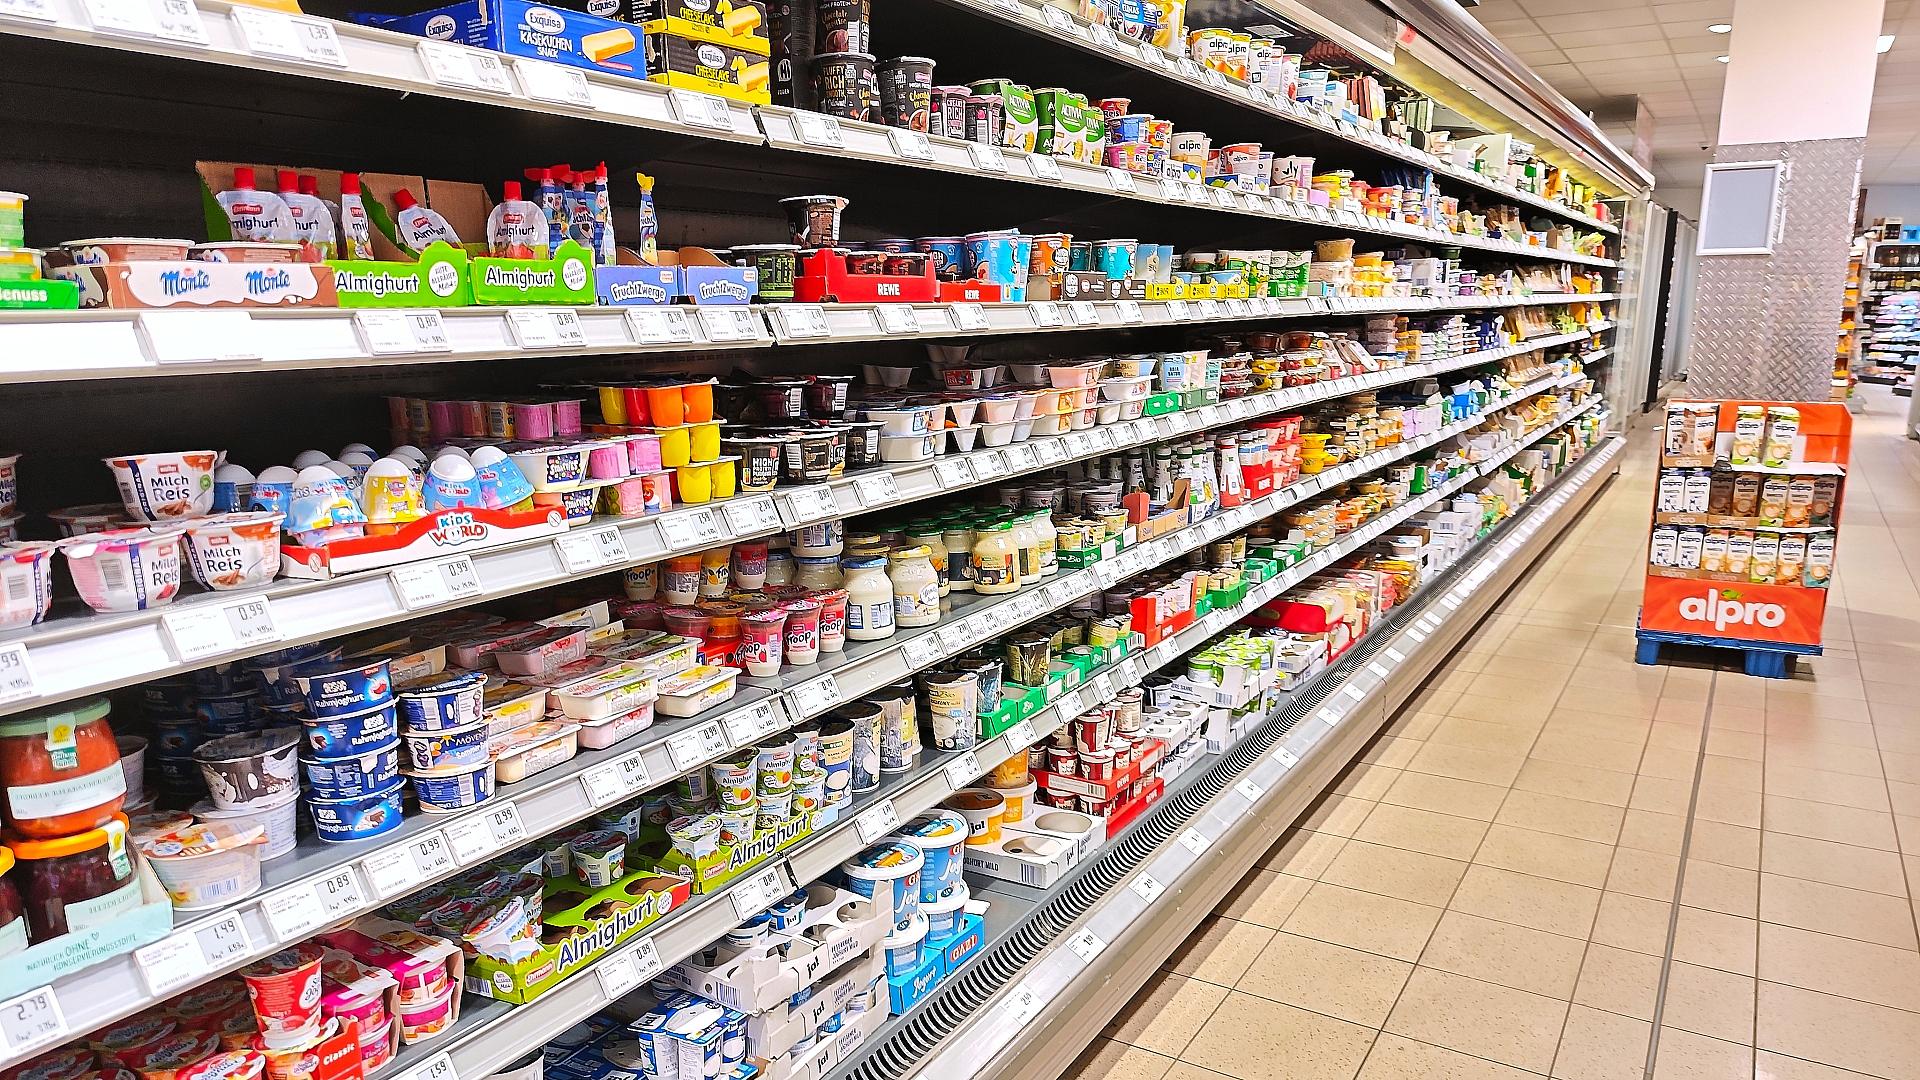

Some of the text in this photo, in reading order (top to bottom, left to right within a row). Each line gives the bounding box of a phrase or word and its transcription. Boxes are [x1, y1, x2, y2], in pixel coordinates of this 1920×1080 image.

[529, 12, 561, 29] Exquisa
[428, 22, 454, 37] Exquisa
[824, 76, 844, 89] RICH
[947, 107, 963, 120] RICH
[161, 270, 210, 296] Monte
[246, 270, 291, 295] Monte
[336, 271, 419, 298] Almighurt
[486, 267, 555, 290] Almighurt
[0, 290, 48, 302] enuss
[877, 283, 900, 297] REWE
[752, 457, 773, 468] HIGH
[151, 475, 189, 488] Milch
[153, 487, 190, 503] Reis
[203, 546, 241, 559] Milch
[207, 556, 242, 573] Reis
[1679, 588, 1786, 633] alpro
[0, 653, 19, 673] .99
[420, 838, 440, 856] 0.99
[730, 812, 809, 870] Almighurt
[558, 891, 656, 972] Almighurt
[65, 939, 90, 957] OHNE
[323, 1041, 355, 1066] Classic
